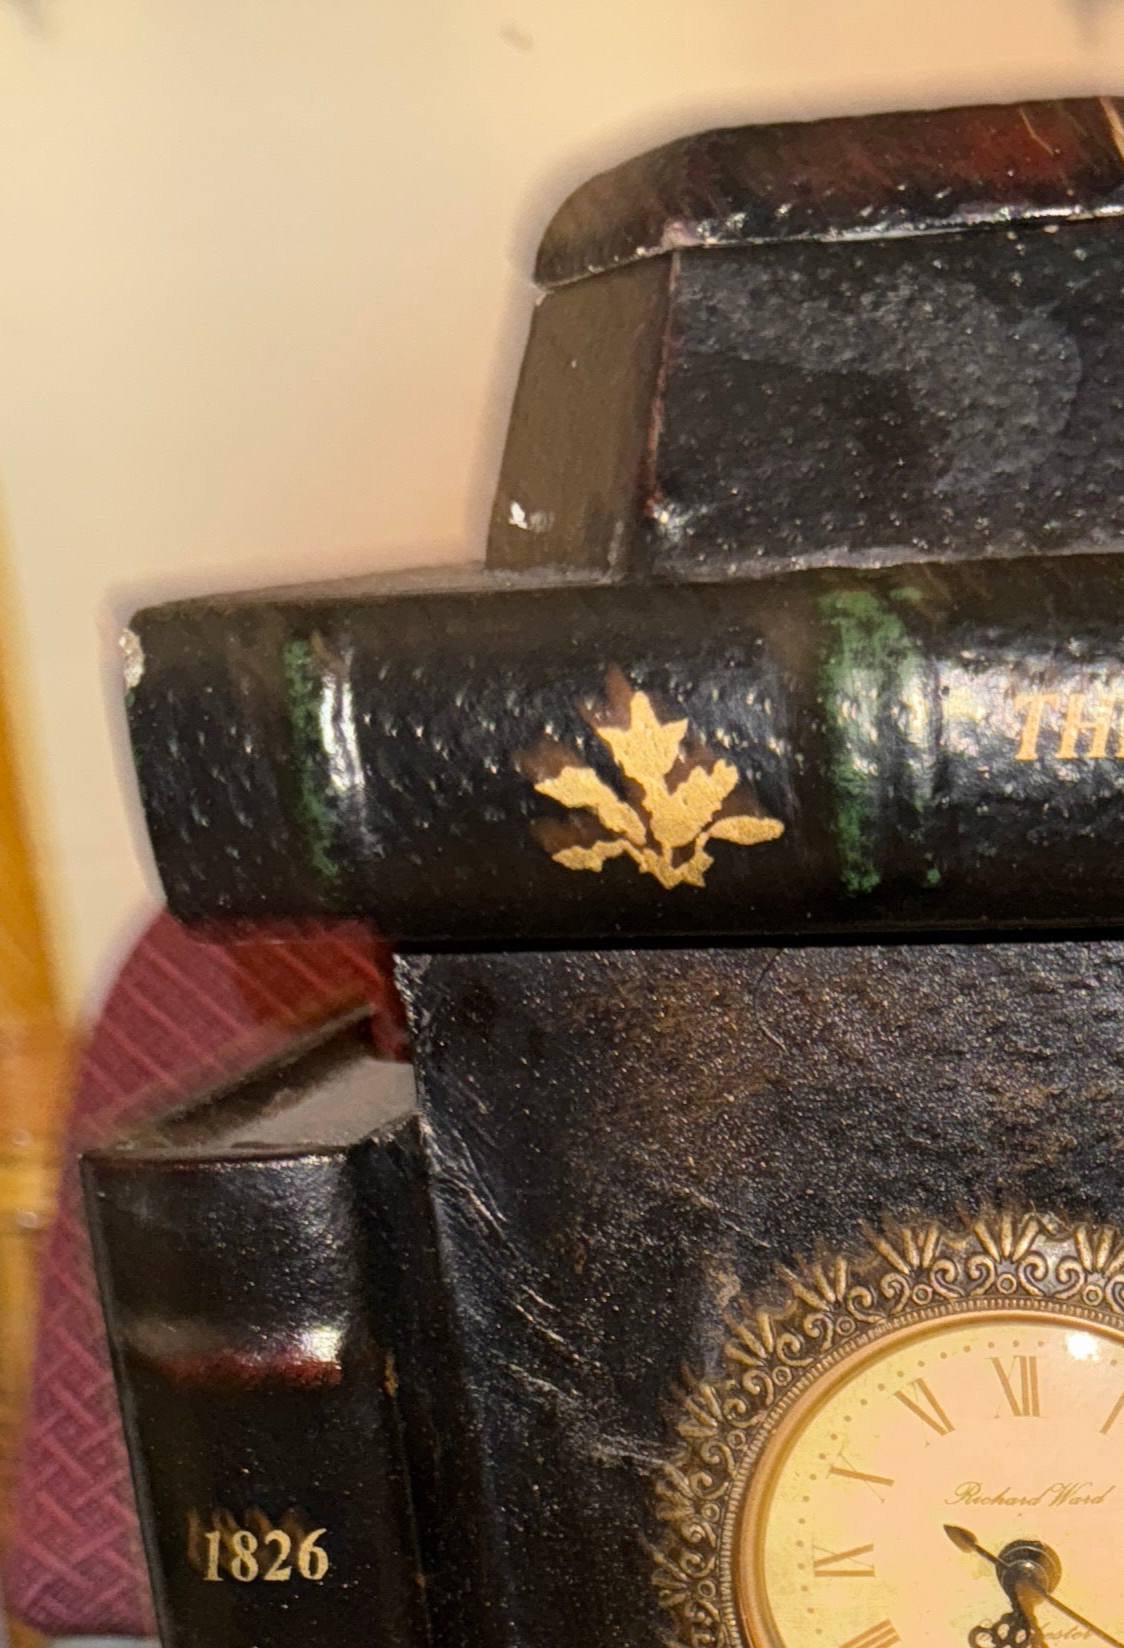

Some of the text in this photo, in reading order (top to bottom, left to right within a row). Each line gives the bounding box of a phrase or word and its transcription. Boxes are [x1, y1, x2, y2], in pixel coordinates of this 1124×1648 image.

[890, 1377, 956, 1447] XI
[986, 1354, 1042, 1419] XII
[826, 1447, 894, 1503] X
[944, 1481, 1116, 1507] Richard Ward
[203, 1527, 329, 1582] 1826
